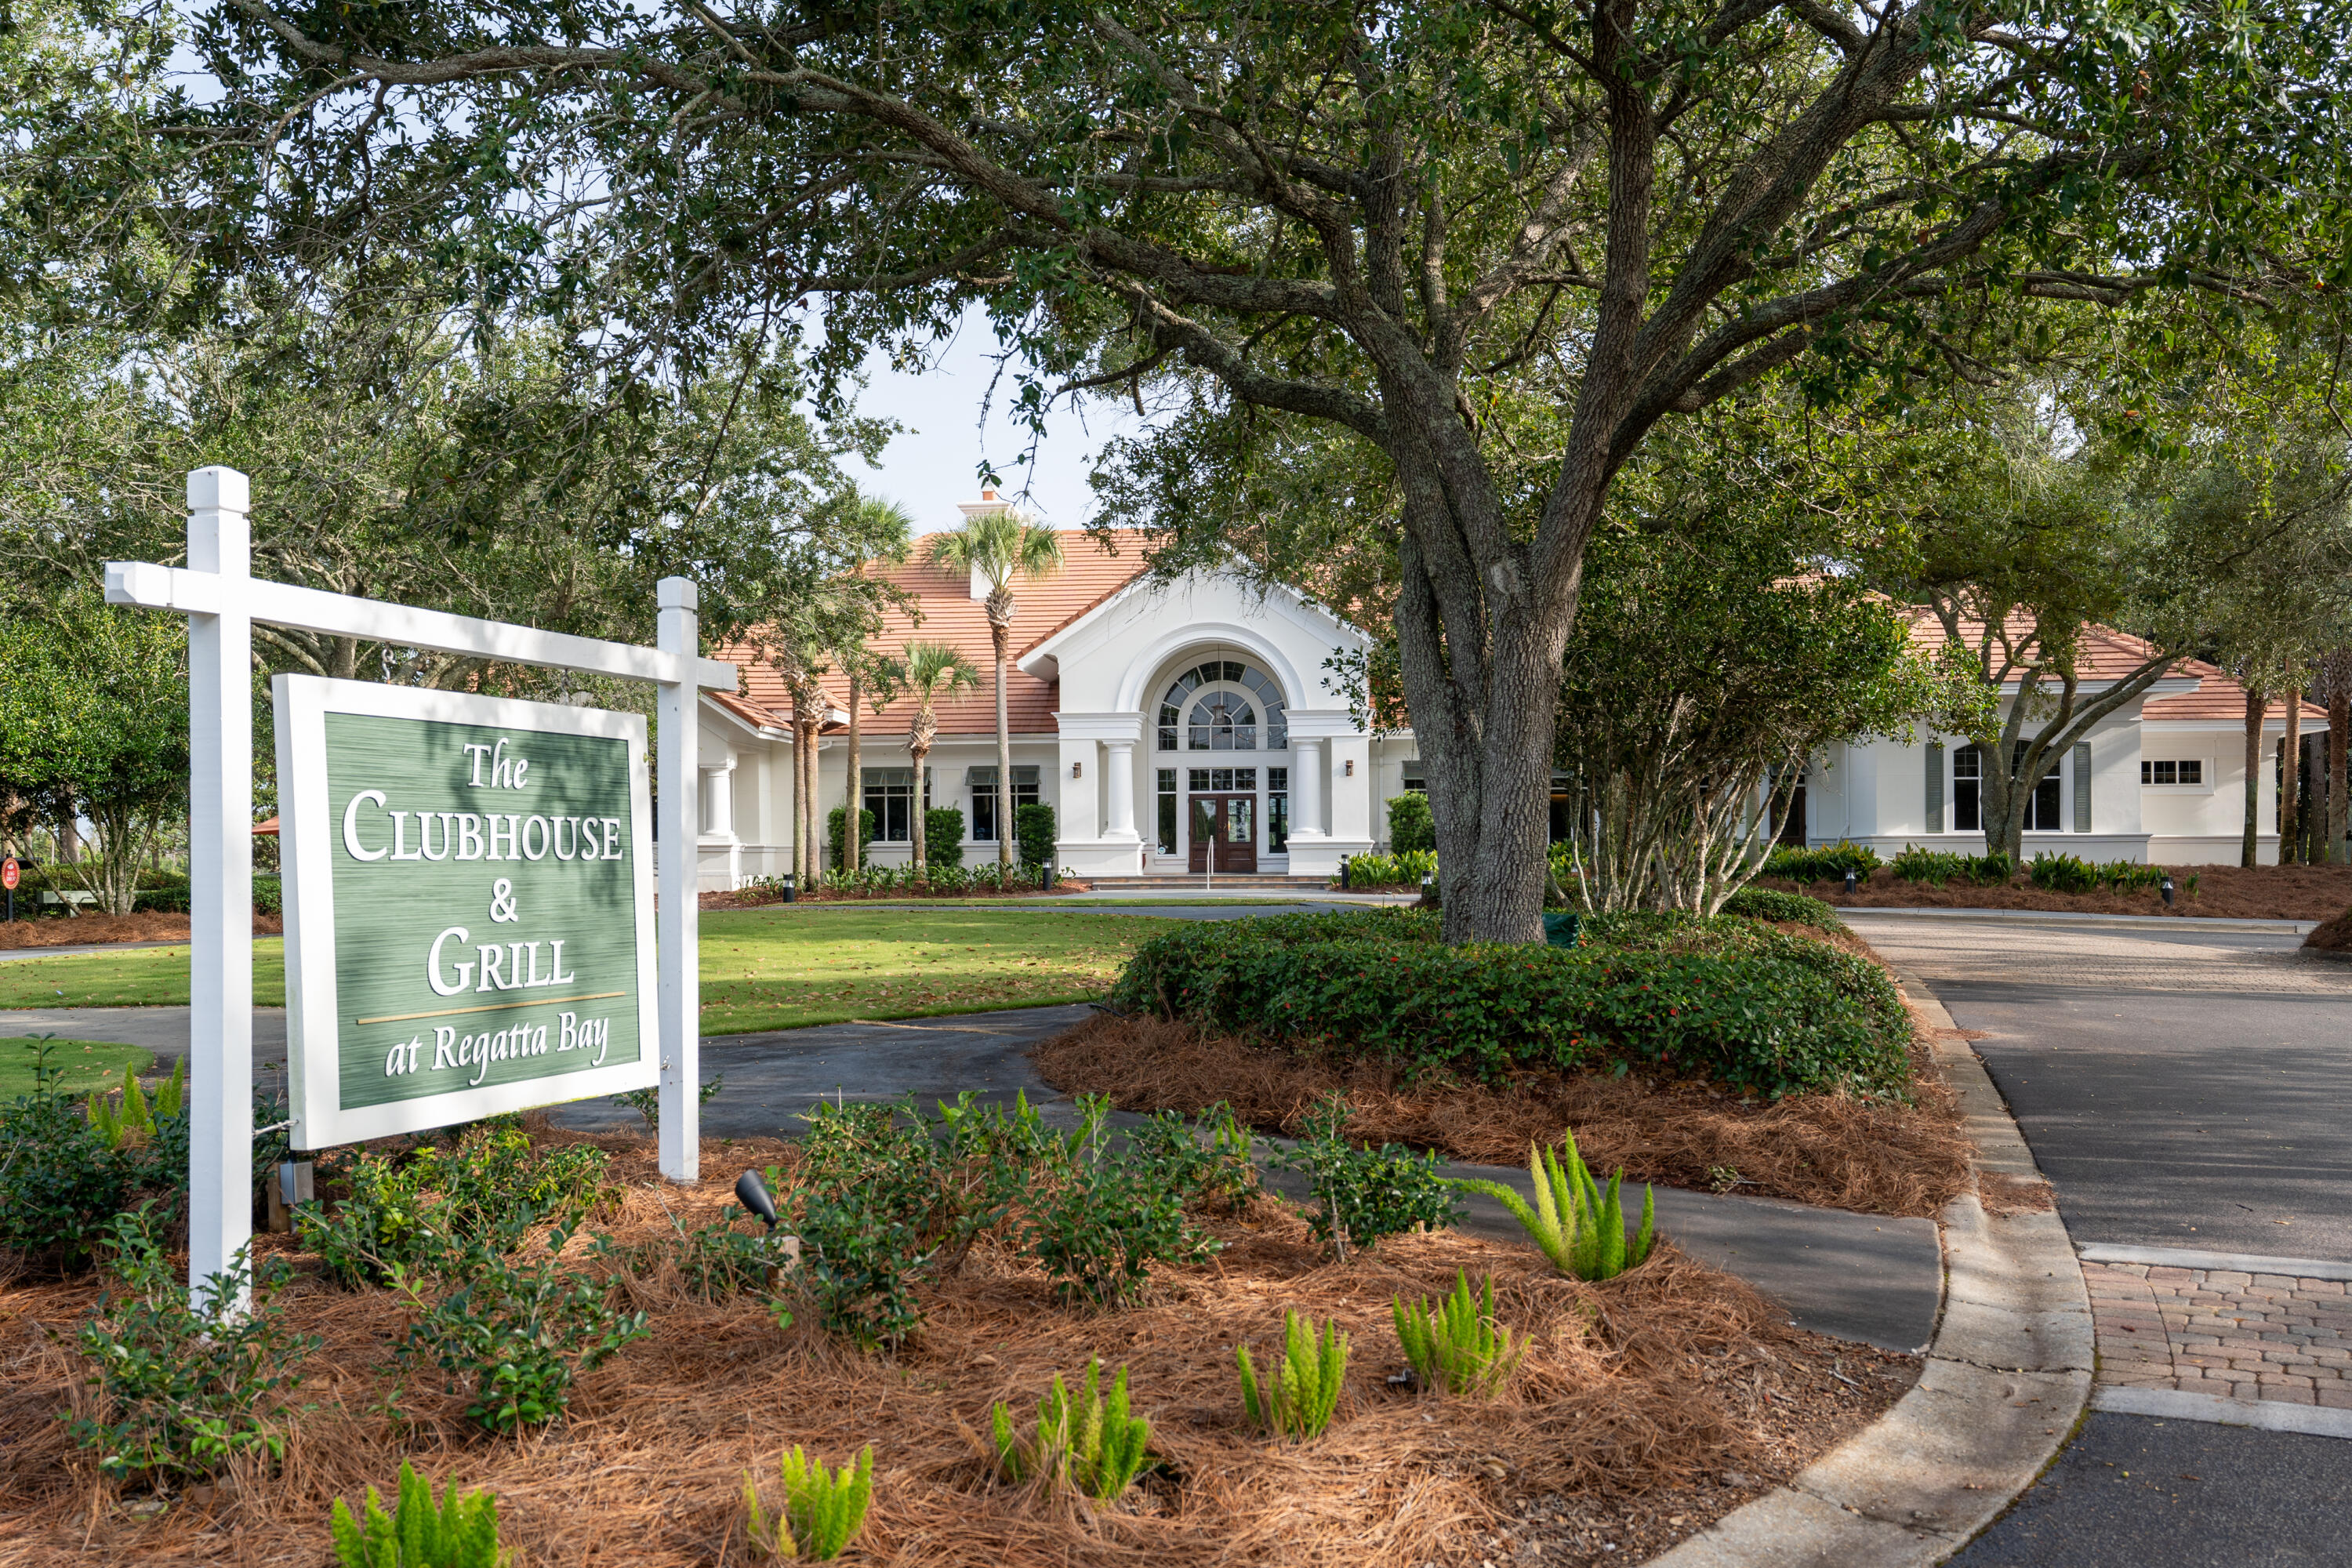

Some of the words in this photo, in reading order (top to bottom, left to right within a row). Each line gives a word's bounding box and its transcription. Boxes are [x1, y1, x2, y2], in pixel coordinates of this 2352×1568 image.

[463, 737, 528, 789] The
[343, 789, 623, 862] CLUBHOUSE
[489, 877, 518, 923] &
[427, 926, 575, 996] GRILL
[384, 1034, 423, 1077] at
[430, 1021, 547, 1087] Regatta
[555, 1011, 609, 1067] Bay
